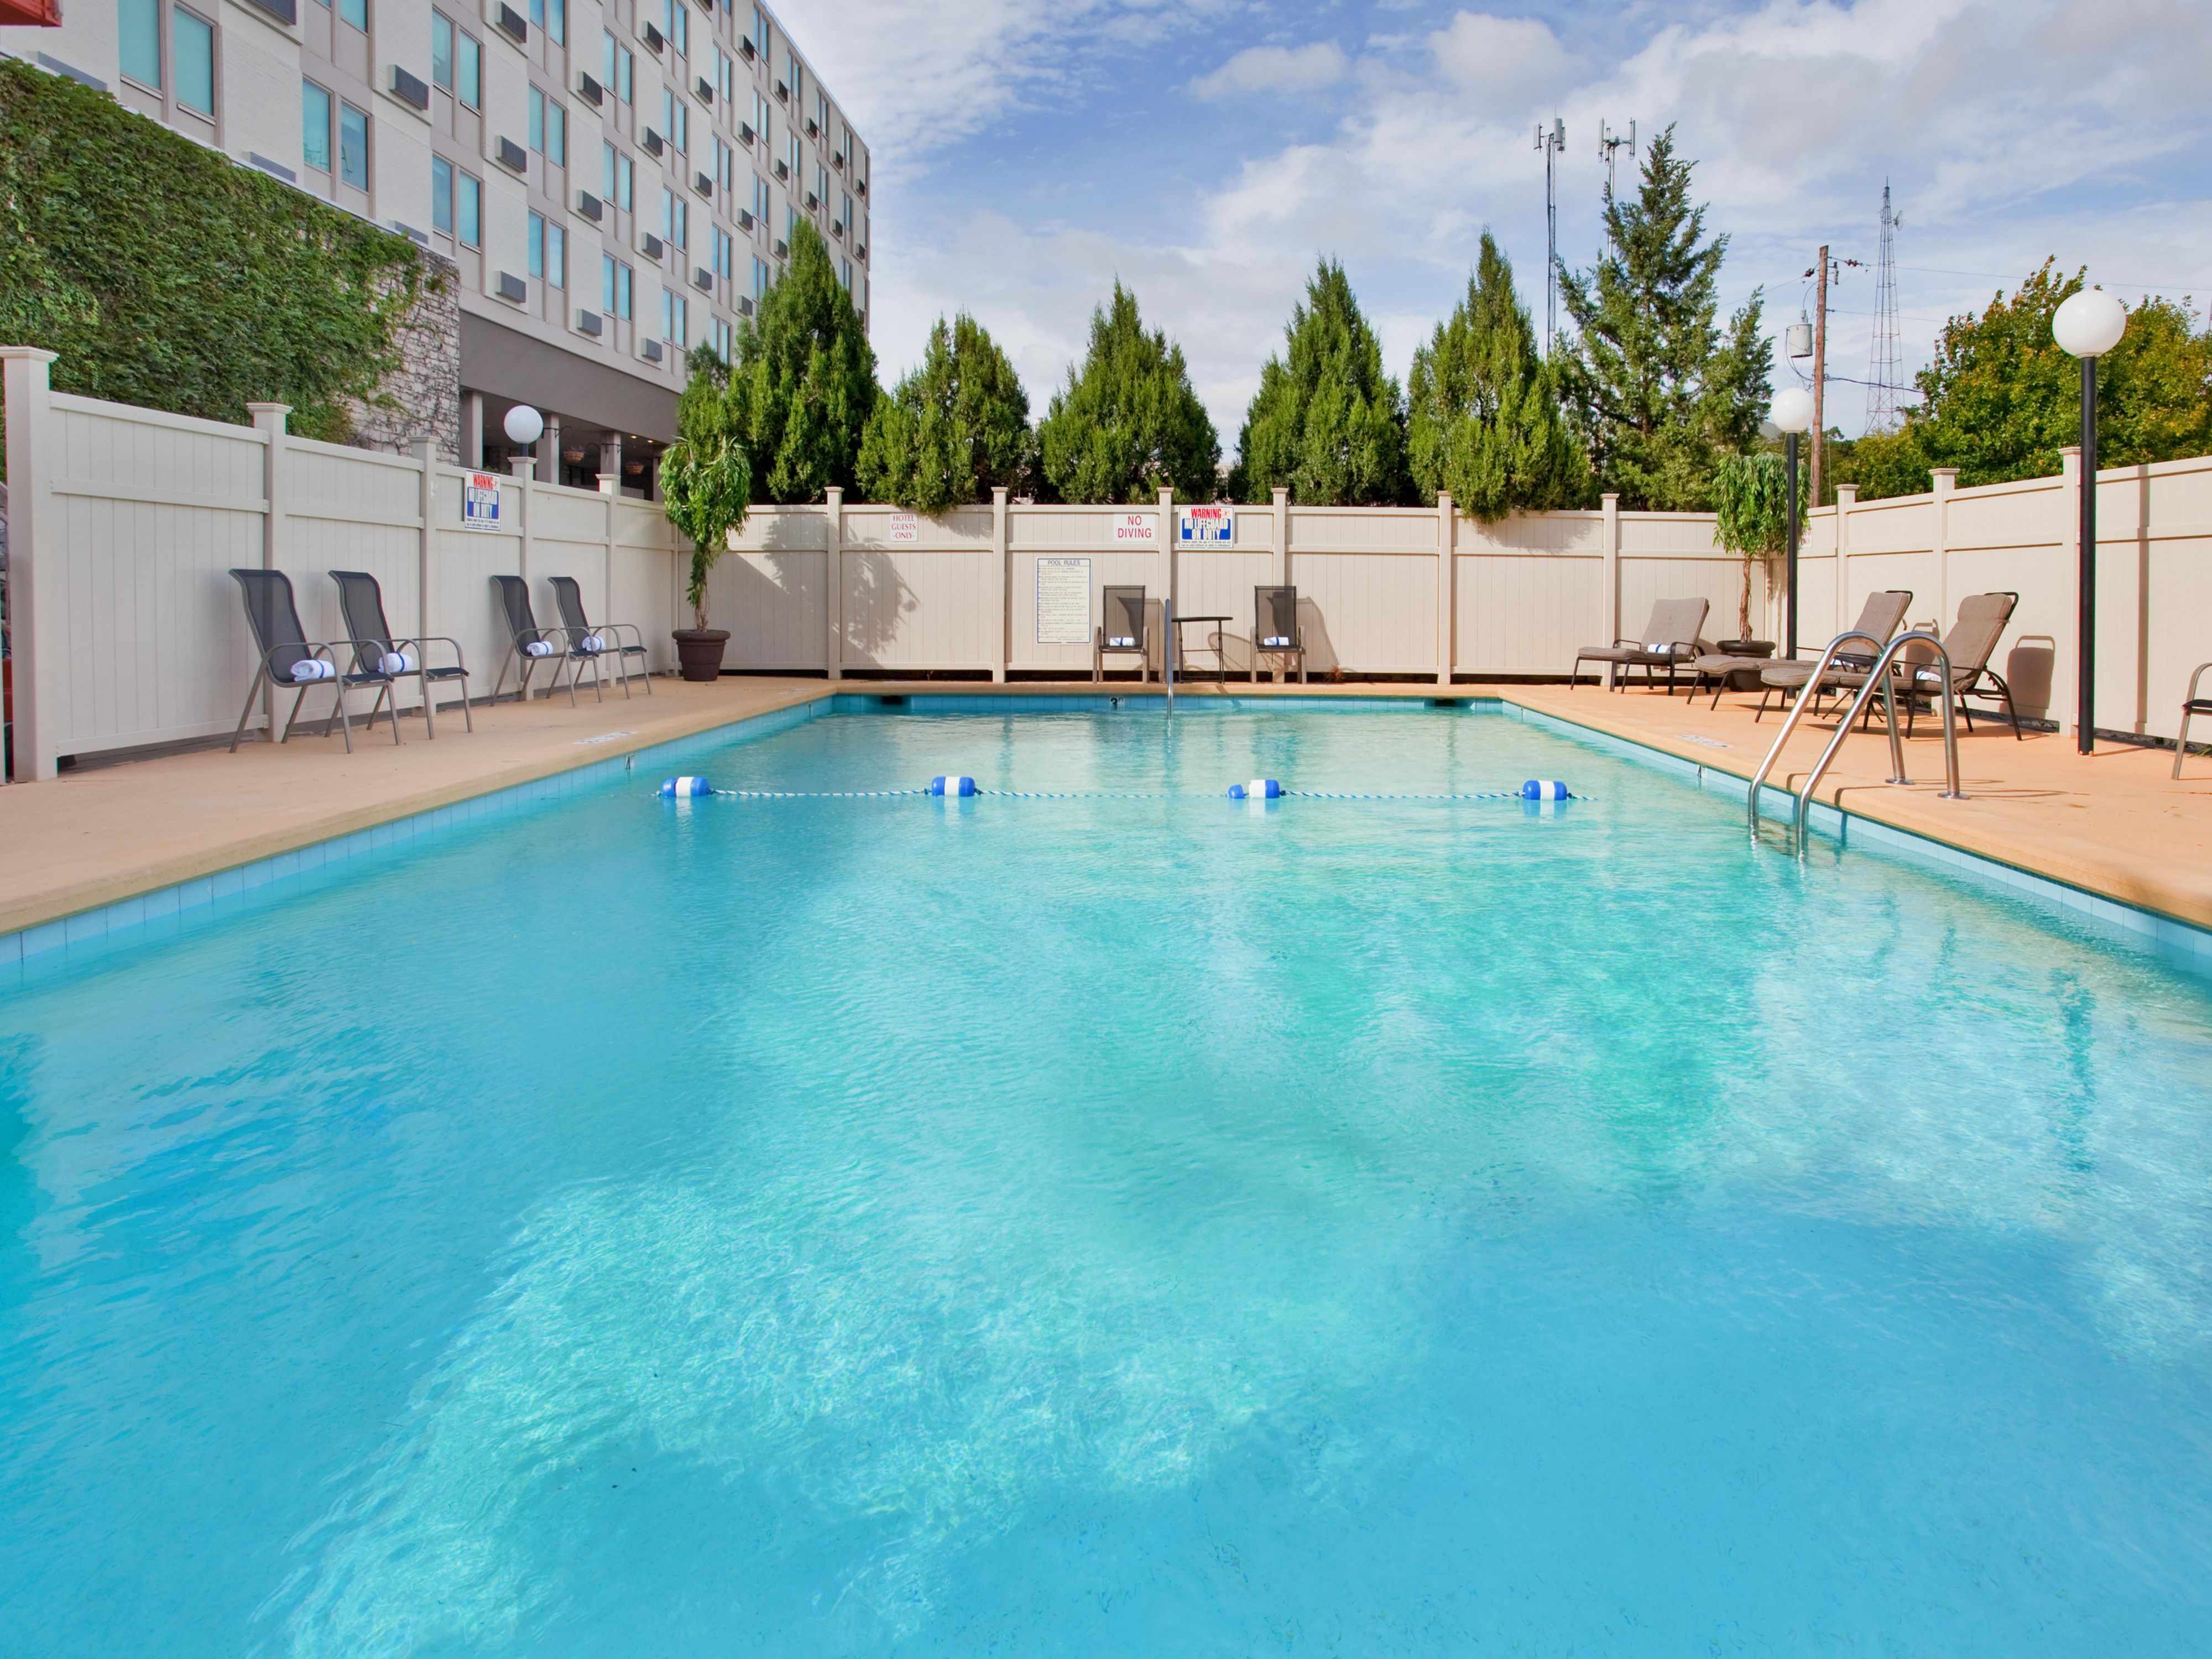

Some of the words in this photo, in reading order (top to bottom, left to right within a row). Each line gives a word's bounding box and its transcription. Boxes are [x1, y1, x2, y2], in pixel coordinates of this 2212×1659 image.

[473, 474, 493, 490] WARNING
[1191, 508, 1222, 519] WARNING
[1128, 515, 1142, 526] NO
[1184, 519, 1193, 530] NO
[1194, 519, 1228, 530] LIFEGUARD
[1118, 528, 1152, 538] DIVING
[1192, 529, 1201, 540] ON
[1203, 529, 1221, 540] DUTY
